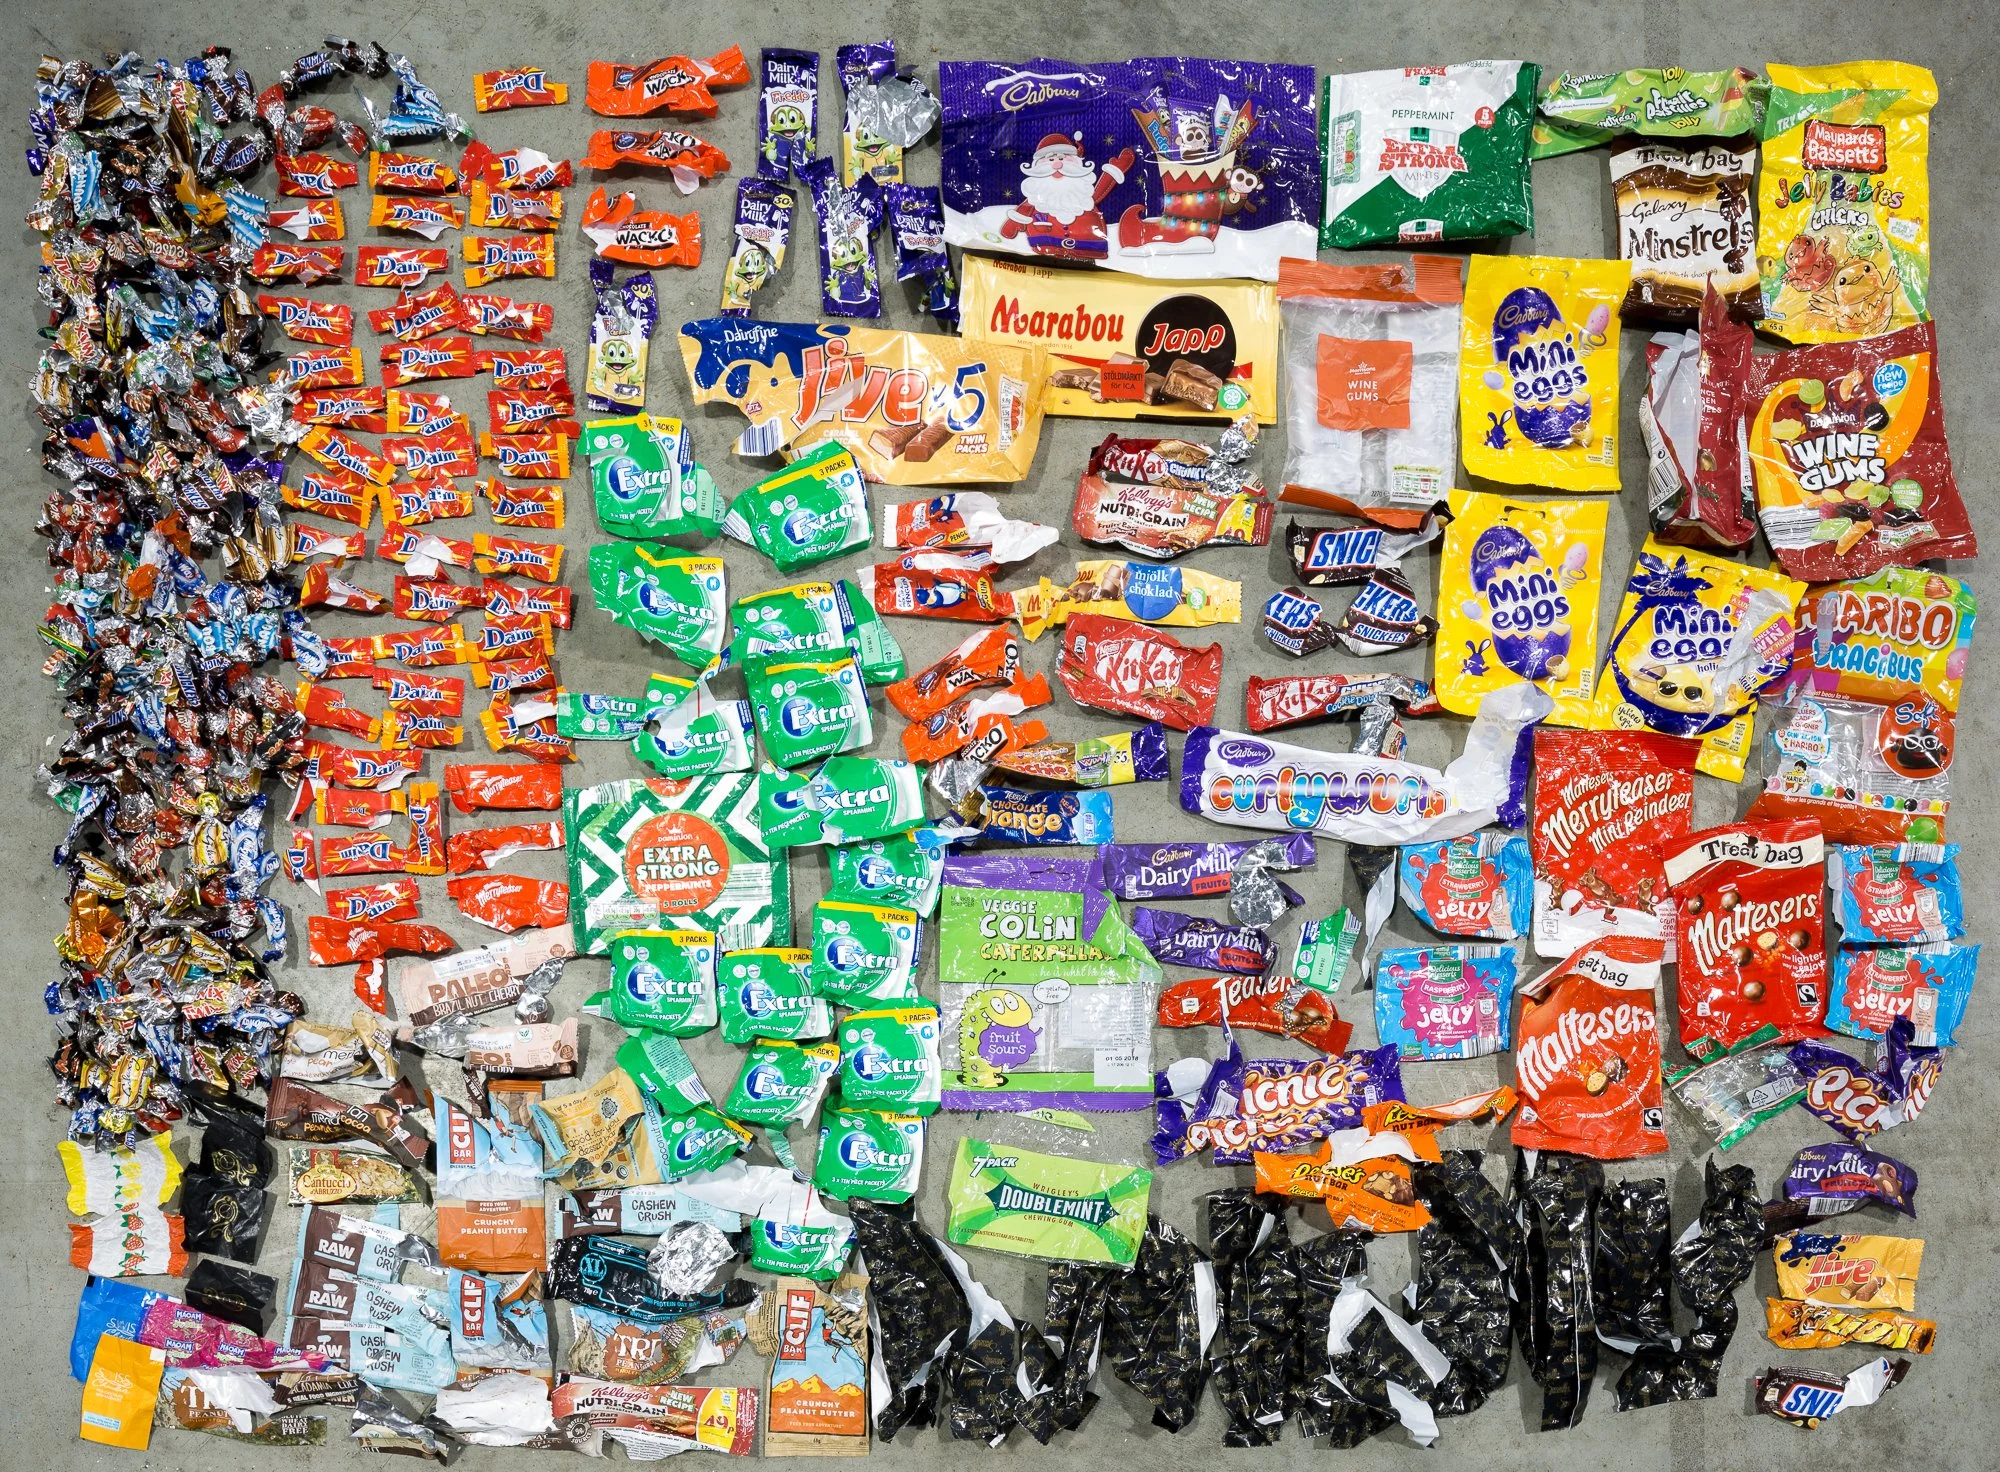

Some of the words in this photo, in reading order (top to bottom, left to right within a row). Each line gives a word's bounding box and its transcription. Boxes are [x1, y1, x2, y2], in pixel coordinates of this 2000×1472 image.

[768, 61, 799, 74] Dairy
[1662, 66, 1685, 83] lolly
[769, 72, 795, 84] Milk
[771, 91, 810, 104] Freddo
[1001, 80, 1081, 111] Cadbury
[1391, 109, 1455, 120] PEPPERMINT
[1646, 98, 1709, 119] Pastilles
[1668, 117, 1700, 129] lolly
[1777, 114, 1795, 132] TRY
[1814, 127, 1875, 145] Maynards
[1378, 152, 1467, 170] STRONG
[1808, 142, 1879, 164] Bassetts
[1404, 171, 1440, 181] MINTS
[1775, 172, 1826, 208] Jelly
[1830, 174, 1905, 209] Babies
[741, 200, 772, 213] Dairy
[1632, 200, 1688, 223] Galaxy
[741, 210, 768, 222] Milk
[1628, 221, 1754, 263] Minstrels
[1032, 267, 1053, 278] Japp
[990, 294, 1124, 342] Marabou
[1500, 305, 1550, 329] Cadbury
[724, 326, 778, 345] Dairyfine
[1144, 323, 1225, 355] Japp
[1508, 332, 1576, 380] Mini
[288, 355, 343, 378] Daim
[1347, 380, 1378, 390] WINE
[1511, 363, 1588, 402] eggs
[1877, 369, 1902, 383] new
[1878, 378, 1904, 390] recipe
[1122, 382, 1136, 390] ICA
[947, 363, 986, 432] 5
[1347, 392, 1379, 402] GUMS
[960, 434, 985, 444] TWIN
[407, 447, 456, 468] Daim
[955, 444, 988, 453] PACKS
[1794, 433, 1878, 468] WINE
[825, 460, 846, 473] PACKS
[1106, 450, 1166, 482] KitKat
[1170, 462, 1206, 479] CHUNKY
[1799, 458, 1886, 491] GUMS
[618, 467, 671, 492] Extra
[301, 474, 352, 504] Daim
[496, 495, 546, 518] Daim
[1118, 487, 1173, 511] Kellogg's
[1195, 494, 1217, 509] NEW
[1183, 503, 1217, 519] RECIPE
[688, 563, 694, 571] 3
[695, 562, 716, 571] PACKS
[1135, 568, 1168, 582] mjölk
[1129, 581, 1173, 598] choklad
[1489, 568, 1558, 609] Mini
[1491, 597, 1570, 634] eggs
[1654, 605, 1732, 636] Mini
[1354, 622, 1408, 643] SNICKERS
[1754, 626, 1785, 654] WIN
[1105, 640, 1182, 690] KitKat
[1261, 682, 1338, 722] KitKat
[1222, 742, 1270, 762] Cadbury
[1559, 771, 1615, 810] Maltesers
[843, 806, 876, 816] SPEARMINT
[992, 801, 1049, 814] CHOCOLATE
[1541, 772, 1673, 859] Merryteaser
[1624, 791, 1692, 835] Reindeer
[643, 845, 712, 865] EXTRA
[1701, 836, 1759, 862] Treat
[1764, 845, 1804, 864] bag
[635, 860, 720, 881] STRONG
[1140, 864, 1196, 888] Dairy
[1196, 856, 1237, 880] Milk
[645, 879, 712, 892] PEPPERMINTS
[1441, 876, 1487, 892] STRAWBERRY
[672, 898, 698, 908] ROLLS
[981, 899, 1037, 915] VEGGIE
[1436, 900, 1491, 921] jelly
[978, 917, 1077, 941] COLIN
[1688, 892, 1818, 977] Maltesers
[686, 935, 708, 944] PACKS
[1791, 952, 1823, 966] lighter
[1431, 965, 1461, 974] Delicious
[1600, 964, 1629, 986] bag
[428, 969, 509, 1001] PALEO
[636, 972, 703, 996] Extra
[1422, 981, 1468, 995] RASPBERRY
[433, 998, 463, 1017] BRAZIL
[465, 992, 486, 1008] NUT
[489, 984, 521, 1005] CHERRY
[1416, 1004, 1474, 1028] jelly
[988, 1031, 1021, 1044] fruit
[1517, 1003, 1656, 1101] Maltesers
[340, 1116, 371, 1133] cocoa
[454, 1150, 472, 1158] BAR
[969, 1156, 985, 1177] 7
[986, 1156, 1018, 1168] PACK
[301, 1175, 352, 1190] Cantuccio
[1033, 1182, 1080, 1197] WRIGLEY'S
[631, 1200, 676, 1211] CASHEW
[999, 1184, 1105, 1222] DOUBLEMINT
[473, 1219, 515, 1227] CRUNCHY
[637, 1210, 672, 1221] CRUSH
[1023, 1213, 1052, 1225] CHEWING
[1053, 1217, 1074, 1228] GUM
[461, 1226, 495, 1235] PEANUT
[496, 1226, 528, 1235] BUTTER
[775, 1224, 834, 1247] Extra
[318, 1239, 356, 1260] RAW
[308, 1290, 348, 1309] RAW
[461, 1280, 485, 1322] CLIF
[176, 1310, 203, 1320] MAOAM
[784, 1295, 809, 1346] CLIF
[465, 1321, 482, 1331] BAR
[166, 1341, 193, 1351] MAOAM
[783, 1344, 803, 1354] BAR
[592, 1387, 651, 1401] Kellogg's
[668, 1388, 693, 1403] NEW
[576, 1399, 668, 1417] NUTRI-GRAIN
[659, 1395, 695, 1412] RECIPE
[780, 1407, 818, 1417] PEANUT
[820, 1408, 856, 1417] BUTTER
[796, 1400, 841, 1408] CRUNCHY
